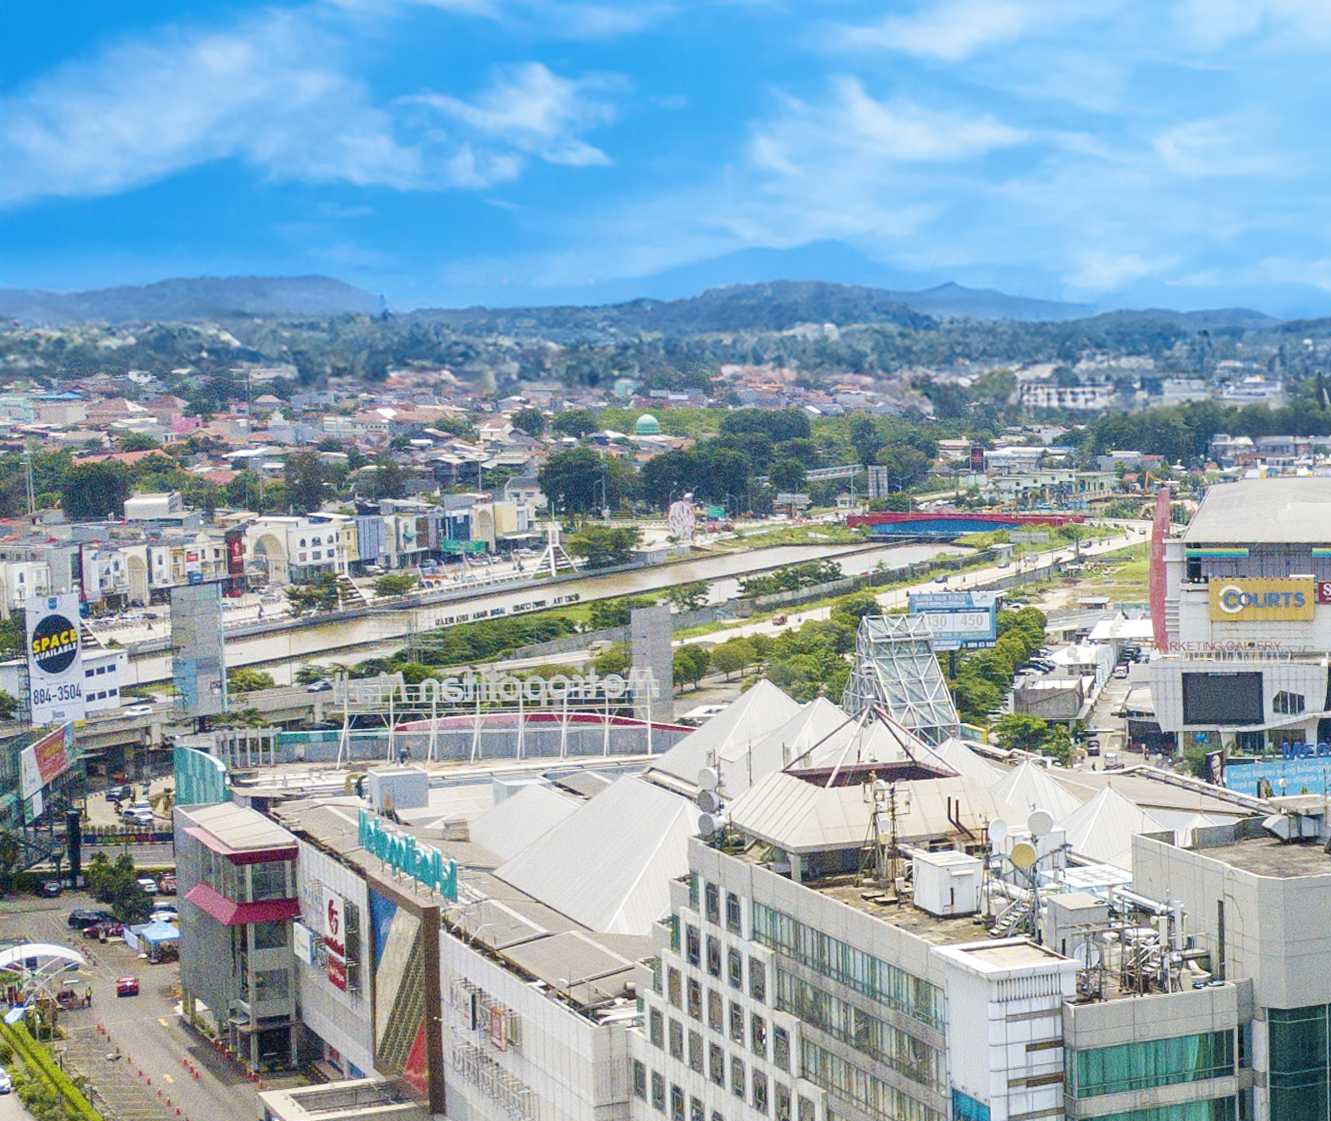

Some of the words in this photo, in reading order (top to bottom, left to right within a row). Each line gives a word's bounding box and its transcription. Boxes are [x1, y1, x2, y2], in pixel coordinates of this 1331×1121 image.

[1219, 584, 1306, 613] COURTS
[32, 628, 78, 653] SPACE
[34, 642, 77, 662] AVAILABLE
[33, 682, 82, 705] 884-3504
